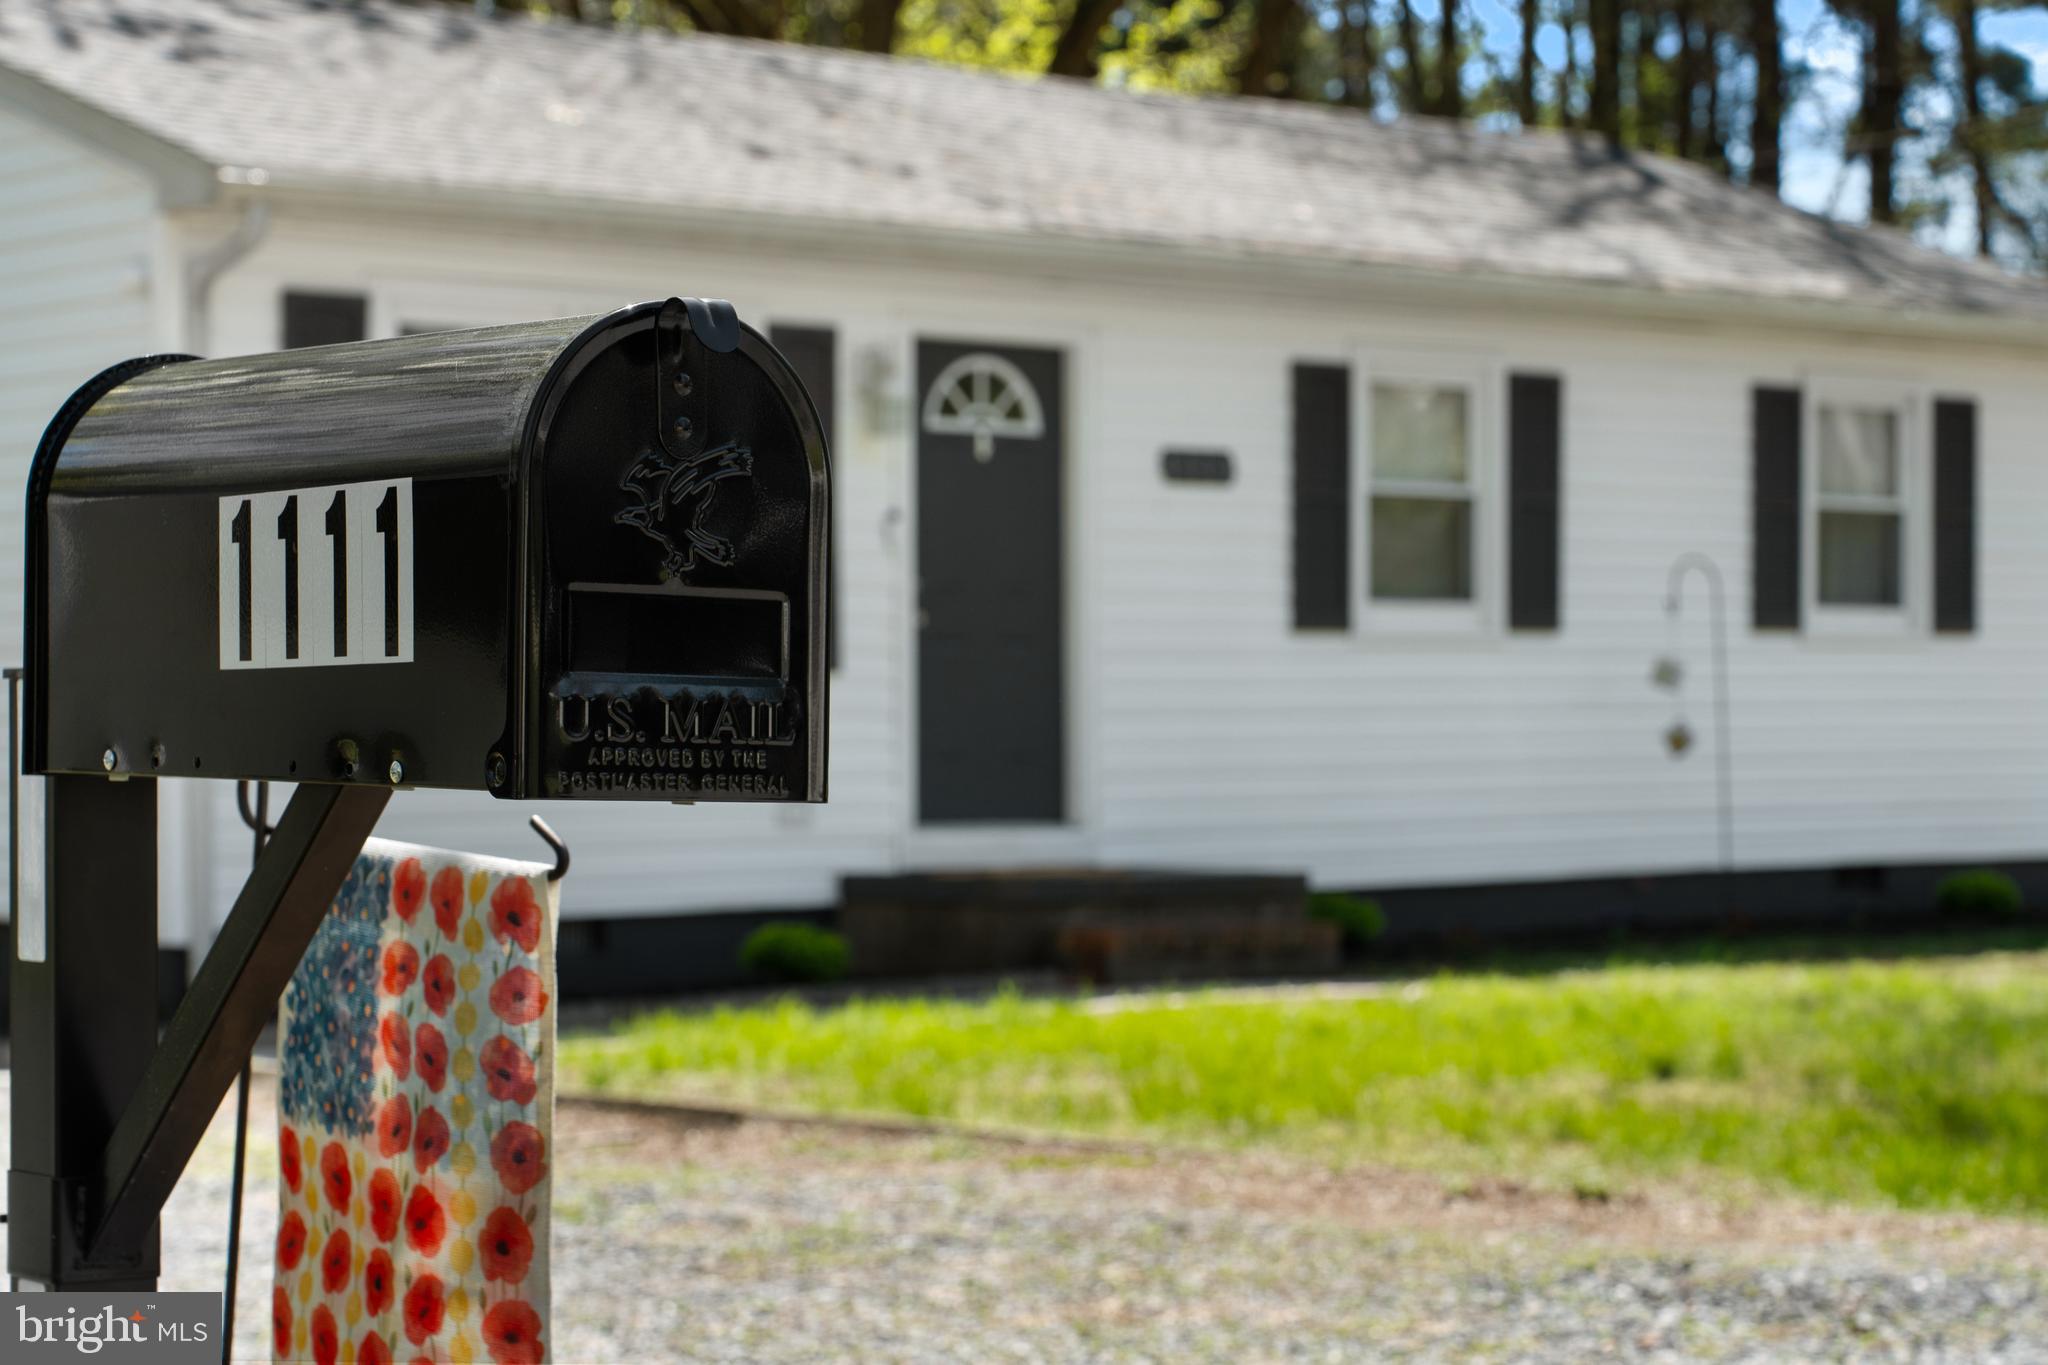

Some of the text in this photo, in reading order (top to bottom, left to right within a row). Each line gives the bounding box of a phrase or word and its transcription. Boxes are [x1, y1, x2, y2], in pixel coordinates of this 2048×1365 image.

[231, 486, 399, 662] 1111
[557, 694, 797, 746] U.S. MAIL
[587, 747, 767, 770] APPROVED BY THE
[557, 770, 790, 796] POSTMASTER GENERAL
